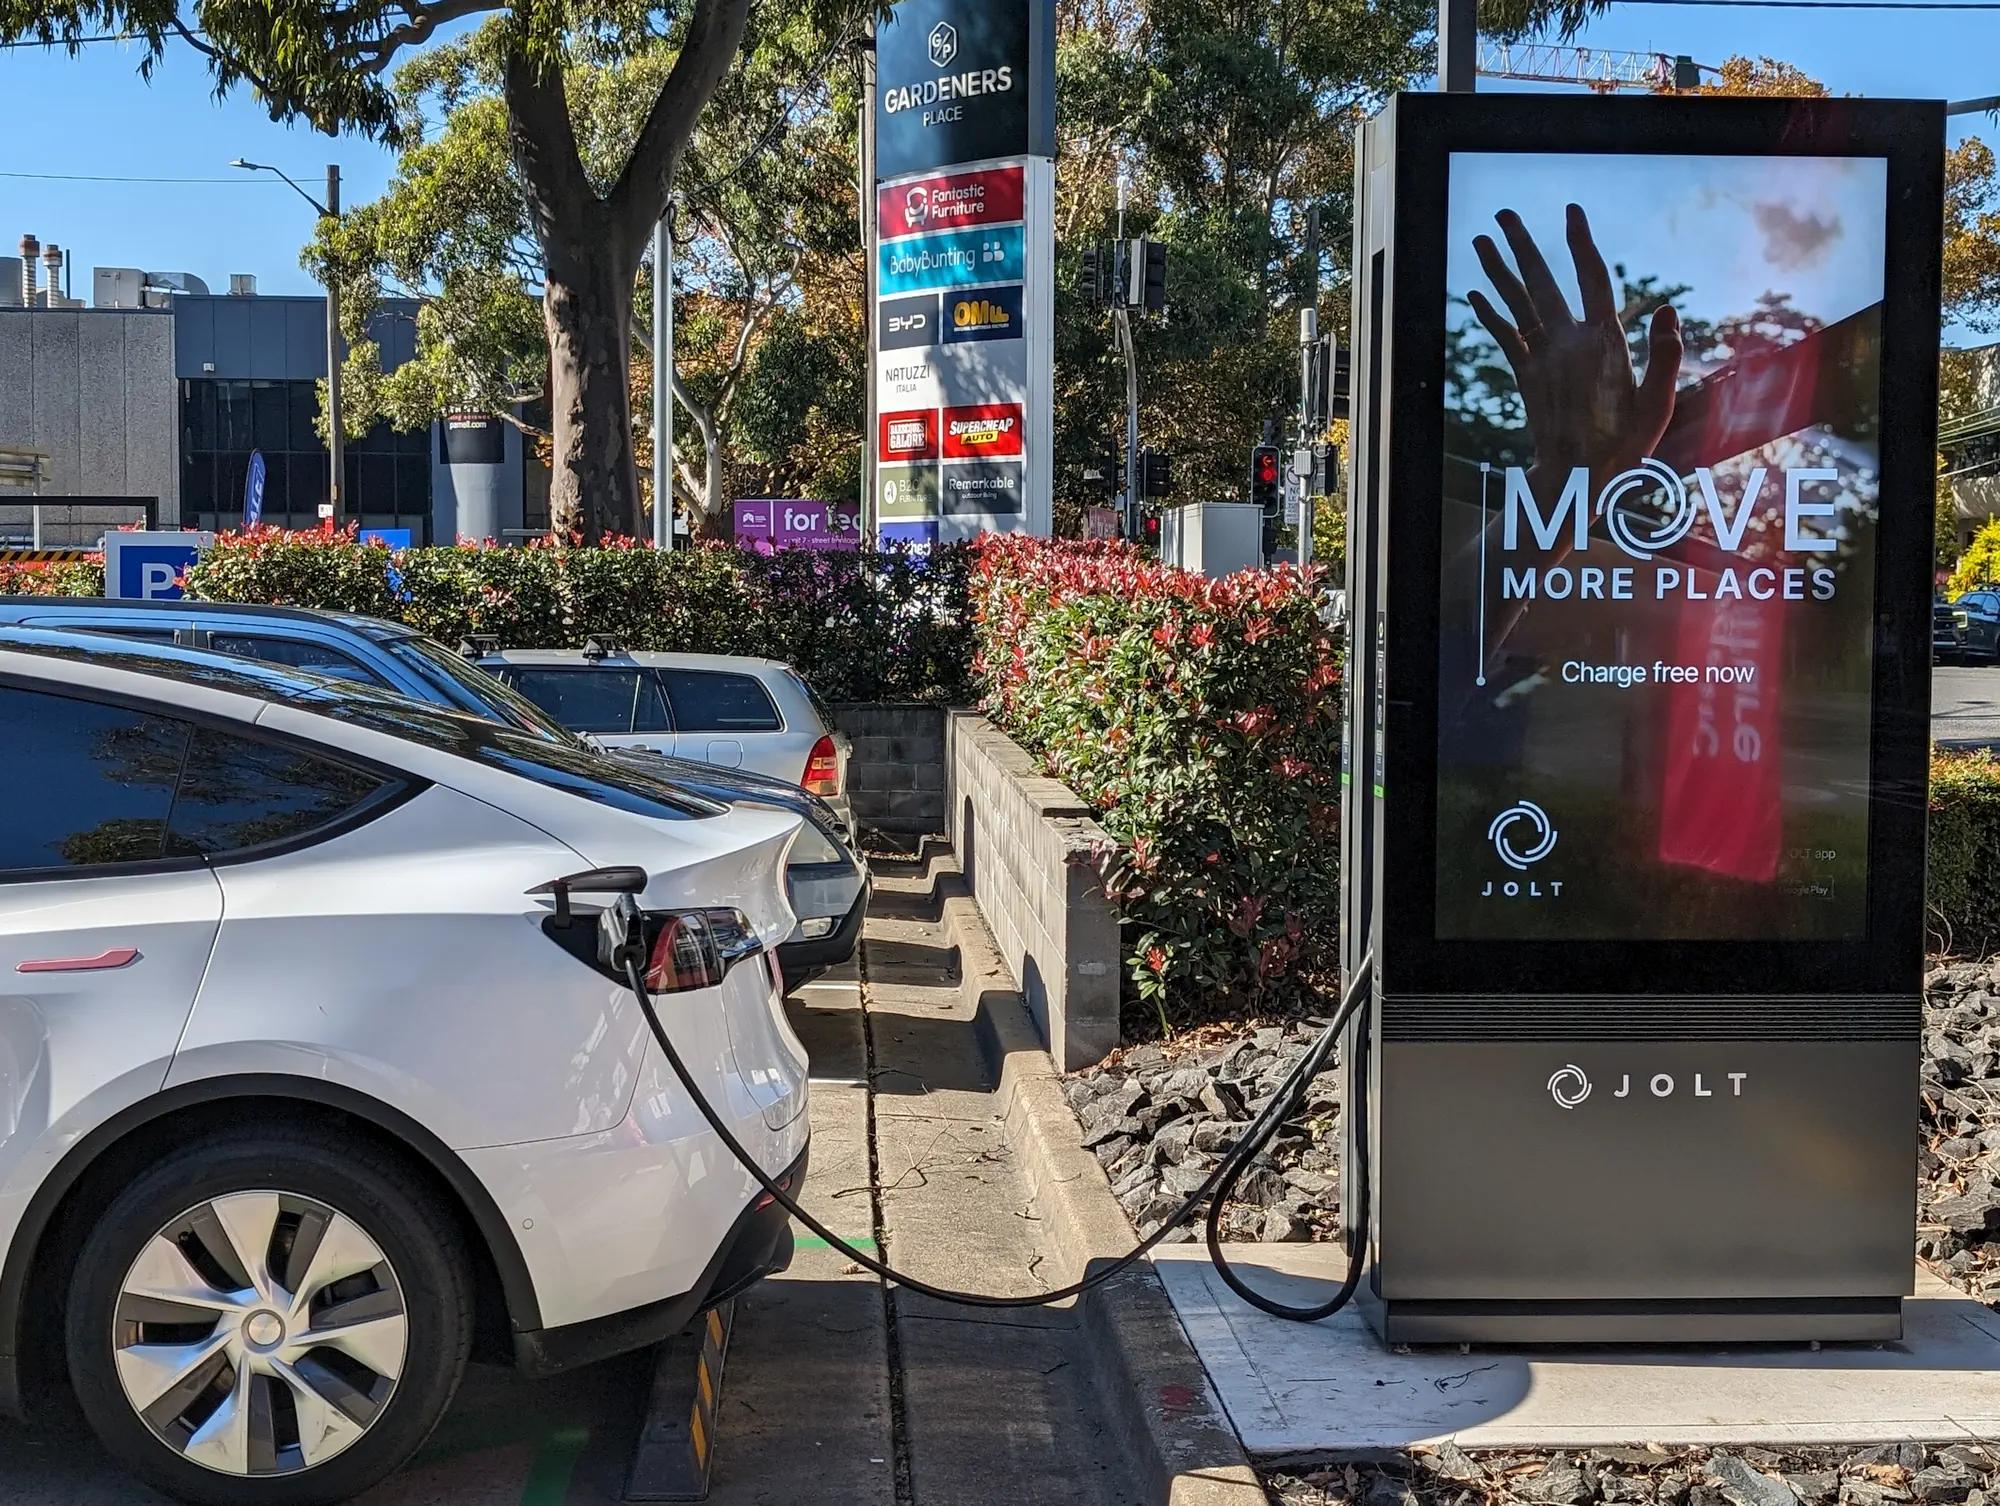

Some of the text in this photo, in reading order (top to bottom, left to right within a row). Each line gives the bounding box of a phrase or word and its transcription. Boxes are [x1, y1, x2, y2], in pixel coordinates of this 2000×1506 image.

[885, 66, 1012, 114] GARDENERS
[923, 106, 963, 127] PLACE
[932, 184, 985, 203] Fantastic
[932, 202, 985, 219] Furniture
[890, 247, 976, 278] BabyBunting
[888, 313, 926, 332] BYD
[886, 364, 930, 383] NATUZZI
[896, 384, 917, 393] ITALIA
[949, 418, 1014, 435] SUPERCHEAP
[890, 433, 925, 449] GALORE
[964, 433, 994, 442] AUTO
[949, 477, 1015, 490] Remarkable
[784, 507, 820, 531] for
[142, 563, 176, 599] P
[1503, 568, 1836, 600] MORE PLACES
[1561, 661, 1755, 688] Charge free now
[1814, 850, 1836, 861] app
[1481, 881, 1563, 897] JOLT
[1613, 1072, 1747, 1098] JOLT
